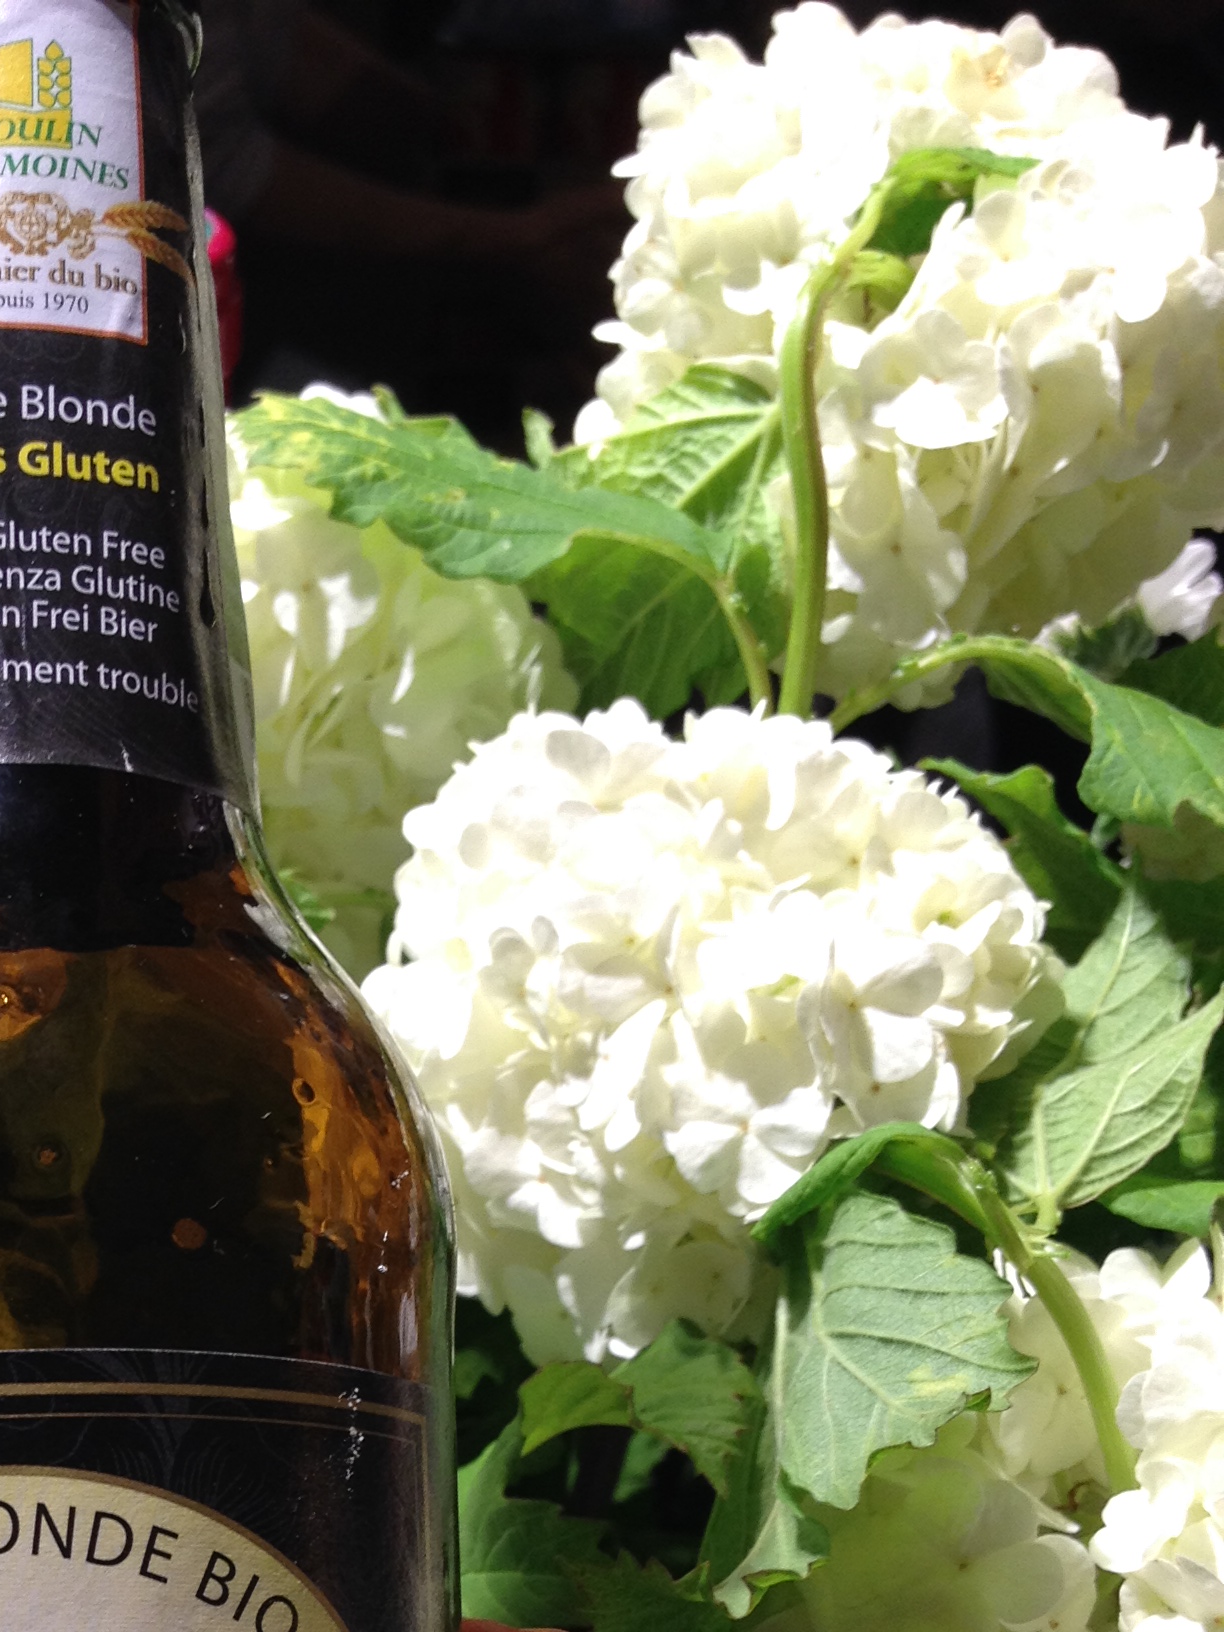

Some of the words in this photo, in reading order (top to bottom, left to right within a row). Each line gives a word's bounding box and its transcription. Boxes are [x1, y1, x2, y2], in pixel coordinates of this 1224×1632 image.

[0, 153, 130, 190] MOINES
[48, 258, 87, 289] du
[94, 262, 139, 296] bio
[44, 291, 89, 315] 1970
[20, 384, 157, 437] Blonde
[17, 440, 160, 493] Gluten
[102, 530, 166, 569] Free
[71, 564, 180, 613] Glutine
[32, 599, 89, 632] Frei
[99, 606, 158, 643] Bier
[97, 662, 199, 714] trouble
